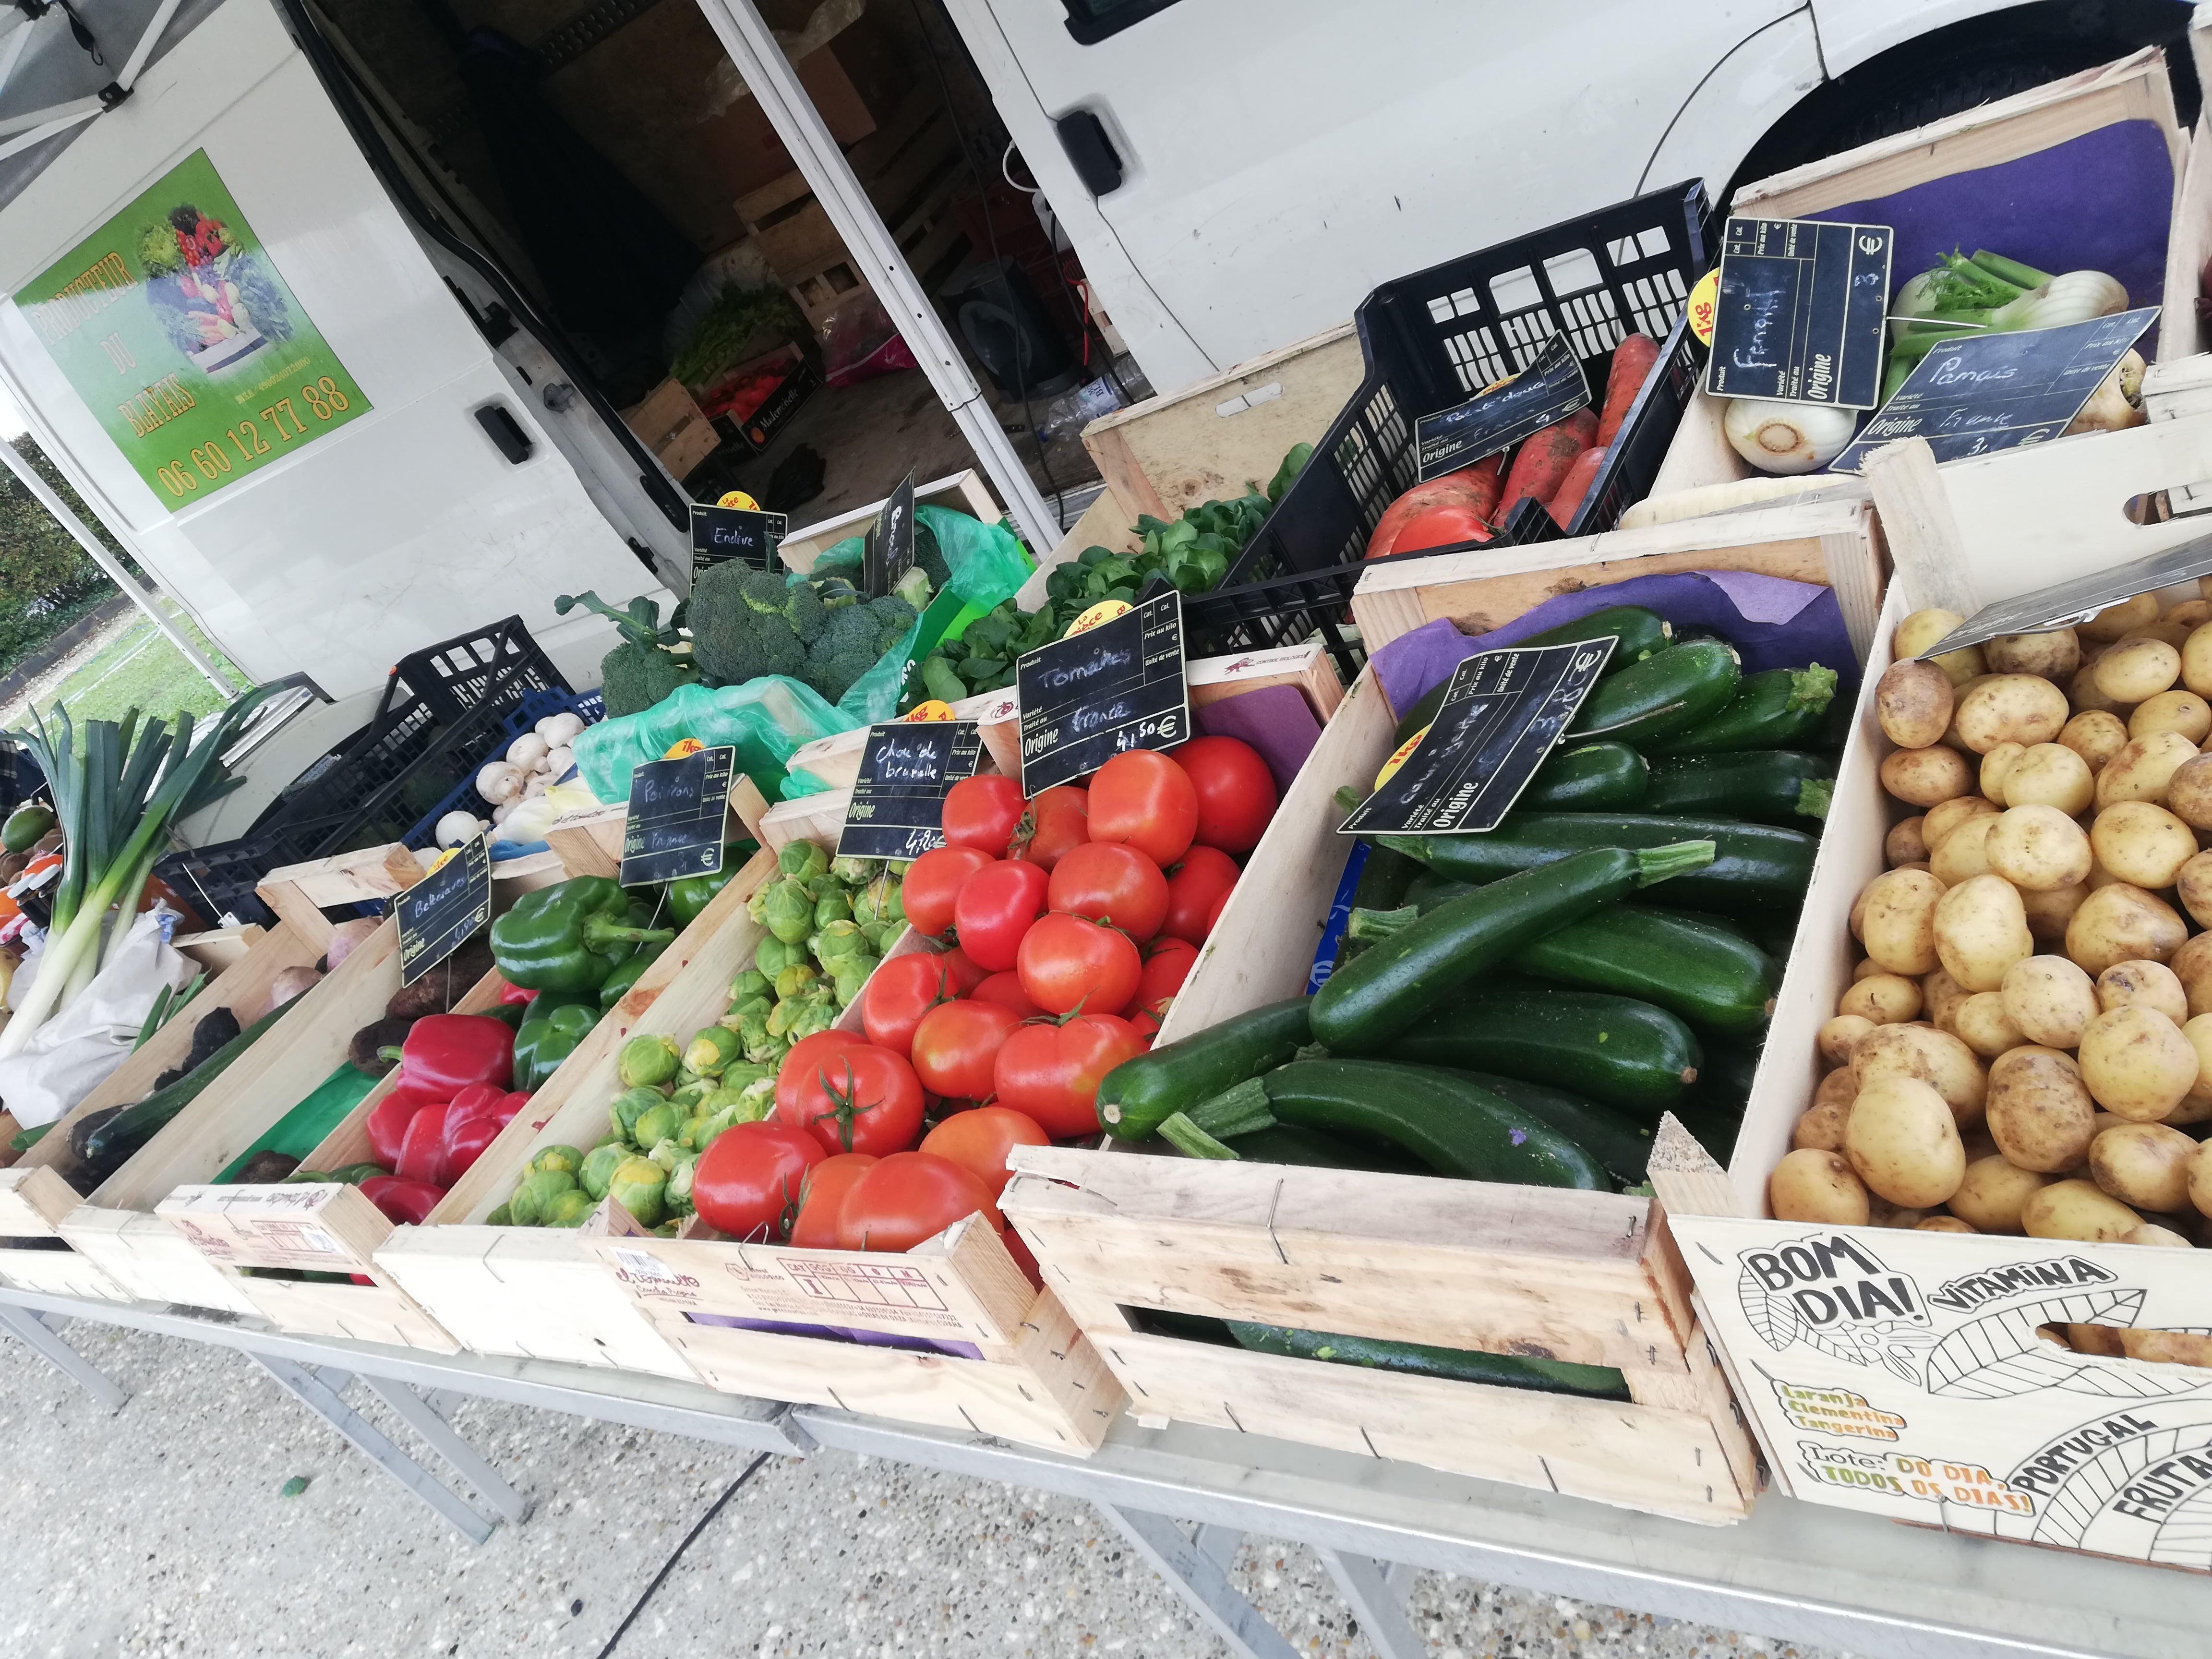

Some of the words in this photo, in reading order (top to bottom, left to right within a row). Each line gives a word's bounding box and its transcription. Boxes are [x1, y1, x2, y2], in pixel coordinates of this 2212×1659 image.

[1858, 235, 1883, 255] €
[31, 252, 138, 345] PRODUCTEUR
[1695, 302, 1713, 337] 1kg
[100, 332, 137, 375] DU
[1933, 345, 1963, 354] Produit
[1717, 366, 1726, 391] Produit
[1793, 366, 1800, 375] au
[1807, 353, 1832, 399] Origine
[1776, 370, 1786, 396] Variété
[1790, 374, 1798, 397] Traité
[118, 373, 196, 438] BLAYAIS
[1896, 393, 1923, 401] Variété
[759, 388, 798, 431] Mademoiselle
[157, 460, 197, 497] 06
[191, 441, 232, 480] 60
[226, 421, 272, 462] 12
[259, 397, 307, 441] 77
[302, 376, 349, 421] 88
[1867, 416, 1923, 436] Origine
[1423, 440, 1462, 463] Origine
[714, 527, 754, 547] Endive
[1144, 631, 1156, 640] Prix
[1165, 623, 1177, 632] kilo
[1020, 657, 1042, 670] Produit
[1145, 656, 1158, 666] Unité
[1165, 649, 1179, 659] vente
[1479, 657, 1488, 670] kilo
[1575, 650, 1602, 672] €
[1476, 671, 1483, 680] au
[1497, 677, 1509, 692] Unité
[1508, 653, 1520, 669] vente
[1468, 682, 1479, 695] Prix
[1023, 706, 1043, 721] Variété
[1023, 720, 1040, 732] Traité
[1157, 715, 1177, 738] €
[1025, 728, 1059, 757] Origine
[849, 801, 875, 820] Origine
[1414, 808, 1433, 829] Traité
[1431, 798, 1441, 807] au
[1433, 782, 1479, 828] Origine
[1348, 807, 1372, 830] Produit
[1401, 804, 1424, 830] Variété
[625, 835, 645, 854] Origine
[700, 848, 714, 866] €
[404, 938, 425, 962] Origine
[786, 1263, 806, 1272] CAT
[1748, 1236, 1882, 1291] BOM
[1794, 1277, 1923, 1325] DIA!
[1781, 1384, 1866, 1407] Laranja
[1789, 1400, 1904, 1427] Clementina
[1794, 1415, 1897, 1439] Tangerina
[1809, 1447, 1886, 1471] Lote:
[1896, 1457, 1932, 1477] DO
[2011, 1414, 2159, 1497] PORTUGAL
[1822, 1466, 1903, 1492] TODOS
[1911, 1480, 1941, 1497] OS
[1954, 1487, 2032, 1513] DIAS!
